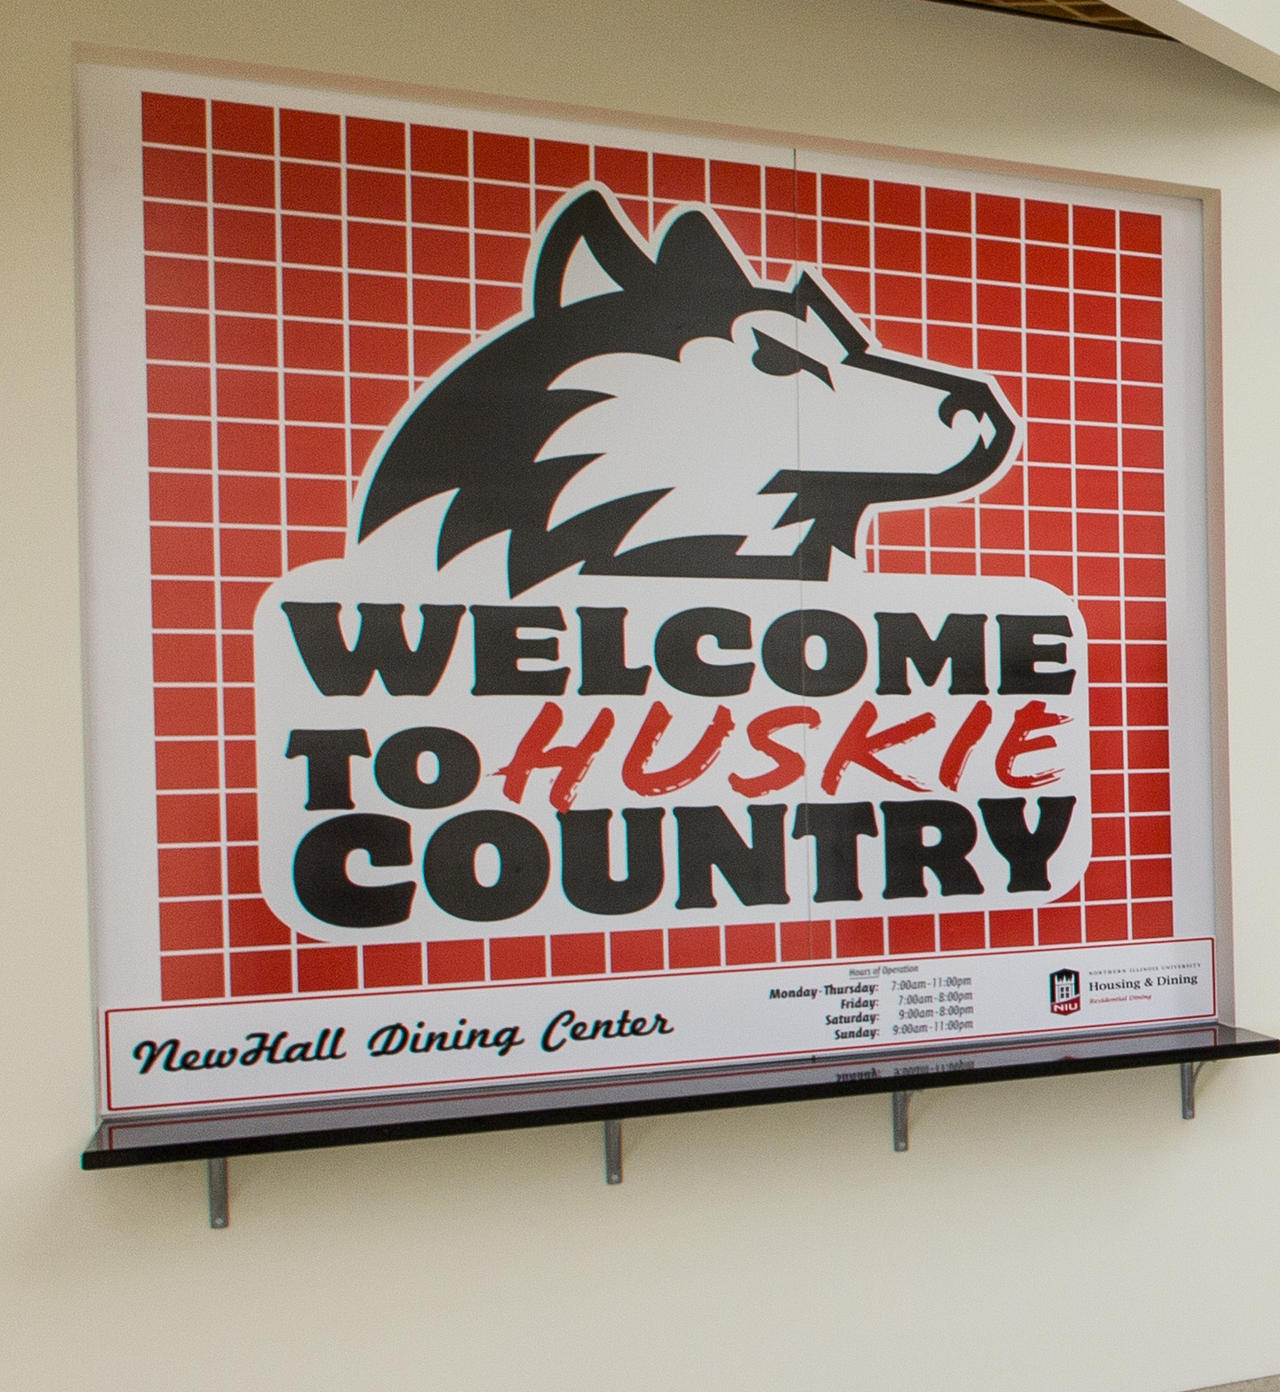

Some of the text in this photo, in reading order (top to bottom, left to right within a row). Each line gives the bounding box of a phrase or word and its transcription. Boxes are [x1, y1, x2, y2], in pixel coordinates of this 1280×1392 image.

[281, 601, 1077, 697] WELCOME
[285, 700, 1076, 813] TO HUSKIE
[292, 796, 1078, 928] COUNTRY
[882, 964, 919, 976] Operation
[1088, 973, 1198, 992] Housing & Dining
[840, 998, 880, 1010] Friday:
[1053, 1003, 1079, 1013] NIU
[825, 1012, 880, 1026] Saturday:
[367, 1018, 525, 1057] Dining
[539, 1009, 675, 1053] Center
[834, 1027, 880, 1041] Sunday:
